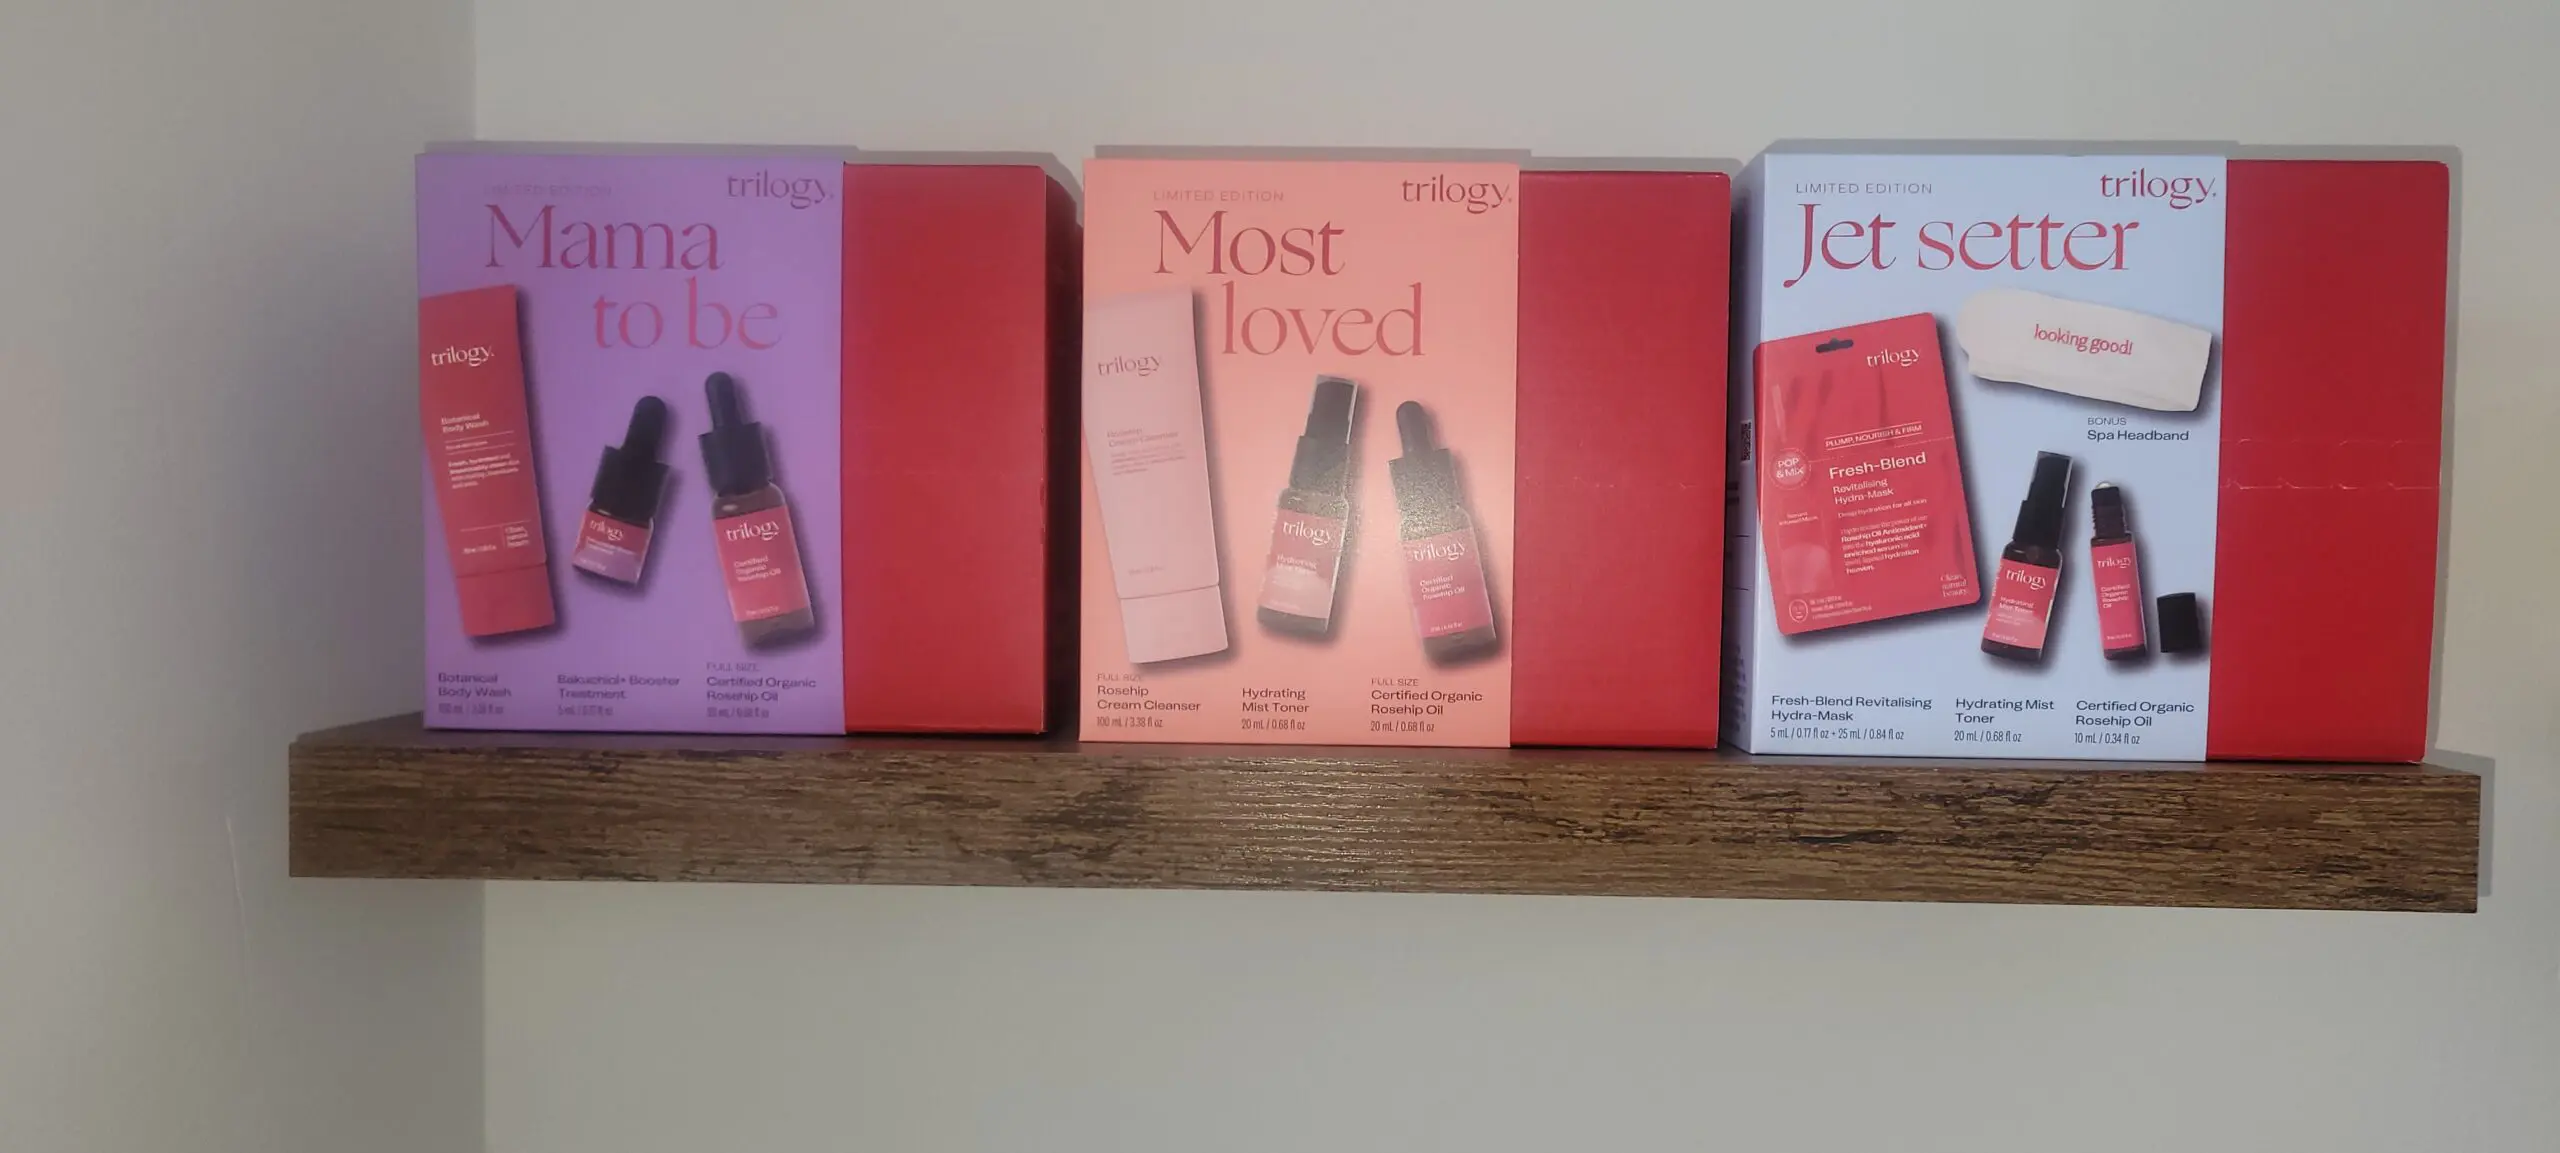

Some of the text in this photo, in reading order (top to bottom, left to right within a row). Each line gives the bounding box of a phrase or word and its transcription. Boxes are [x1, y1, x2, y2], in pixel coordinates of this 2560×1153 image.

[1796, 183, 1932, 195] LIMITED EDITION
[1153, 190, 1284, 202] LIMITED EDITION
[484, 203, 725, 271] Mama
[1154, 210, 1346, 276] Most
[1783, 204, 2139, 288] Jet setter
[594, 276, 784, 351] to be
[1221, 281, 1426, 357] loved
[2033, 324, 2133, 356] looking good!
[2087, 417, 2127, 426] BONUS
[2087, 430, 2189, 443] Spa Headband
[1829, 452, 1927, 480] Fresh-Blend
[1833, 478, 1888, 494] Revitalising
[1835, 488, 1894, 505] Hydra-Mask
[438, 673, 498, 683] Botanical
[707, 677, 816, 689] Certified Organic
[1097, 673, 1119, 682] FULL
[1371, 678, 1419, 687] FULL SIZE
[438, 687, 512, 698] Body Wash
[707, 691, 758, 702] Rosehip
[1097, 685, 1149, 698] Rosehip
[1242, 687, 1305, 700] Hydrating
[1371, 690, 1483, 703] Certified Organic
[1097, 700, 1200, 711] Cream Cleanser
[1242, 702, 1309, 713] Mist Toner
[1772, 695, 1932, 710] Fresh-Blend Revitalising
[1956, 698, 2054, 711] Hydrating Mist
[2076, 700, 2194, 714] Certified Organic
[1371, 704, 1443, 716] Rosehip Oil
[1772, 710, 1853, 722] Hydra-Mask
[1242, 719, 1251, 729] 20
[1253, 719, 1264, 729] mL
[1272, 719, 1288, 730] 0.68
[1296, 722, 1305, 730] oz
[1956, 713, 1995, 724] Toner
[2075, 715, 2152, 728] Rosehip Oil
[1371, 721, 1380, 732] 20
[1382, 721, 1394, 732] mL
[1401, 721, 1417, 732] 0.68
[1426, 724, 1435, 732] oz
[1770, 727, 1776, 738] 5
[1777, 728, 1789, 738] mL
[1796, 728, 1812, 739] 0.17
[1820, 730, 1829, 739] oz
[1838, 728, 1848, 739] 25
[1850, 729, 1860, 739] mL
[1869, 729, 1886, 740] 0.84
[1895, 731, 1904, 740] oz
[1954, 731, 1965, 741] 20
[1966, 731, 1978, 741] mL
[1985, 731, 2004, 742] 0.68
[2012, 734, 2022, 742] oz
[2075, 732, 2083, 743] 10
[2085, 733, 2097, 743] mL
[2105, 733, 2122, 744] 0.34
[2131, 735, 2140, 744] oz
